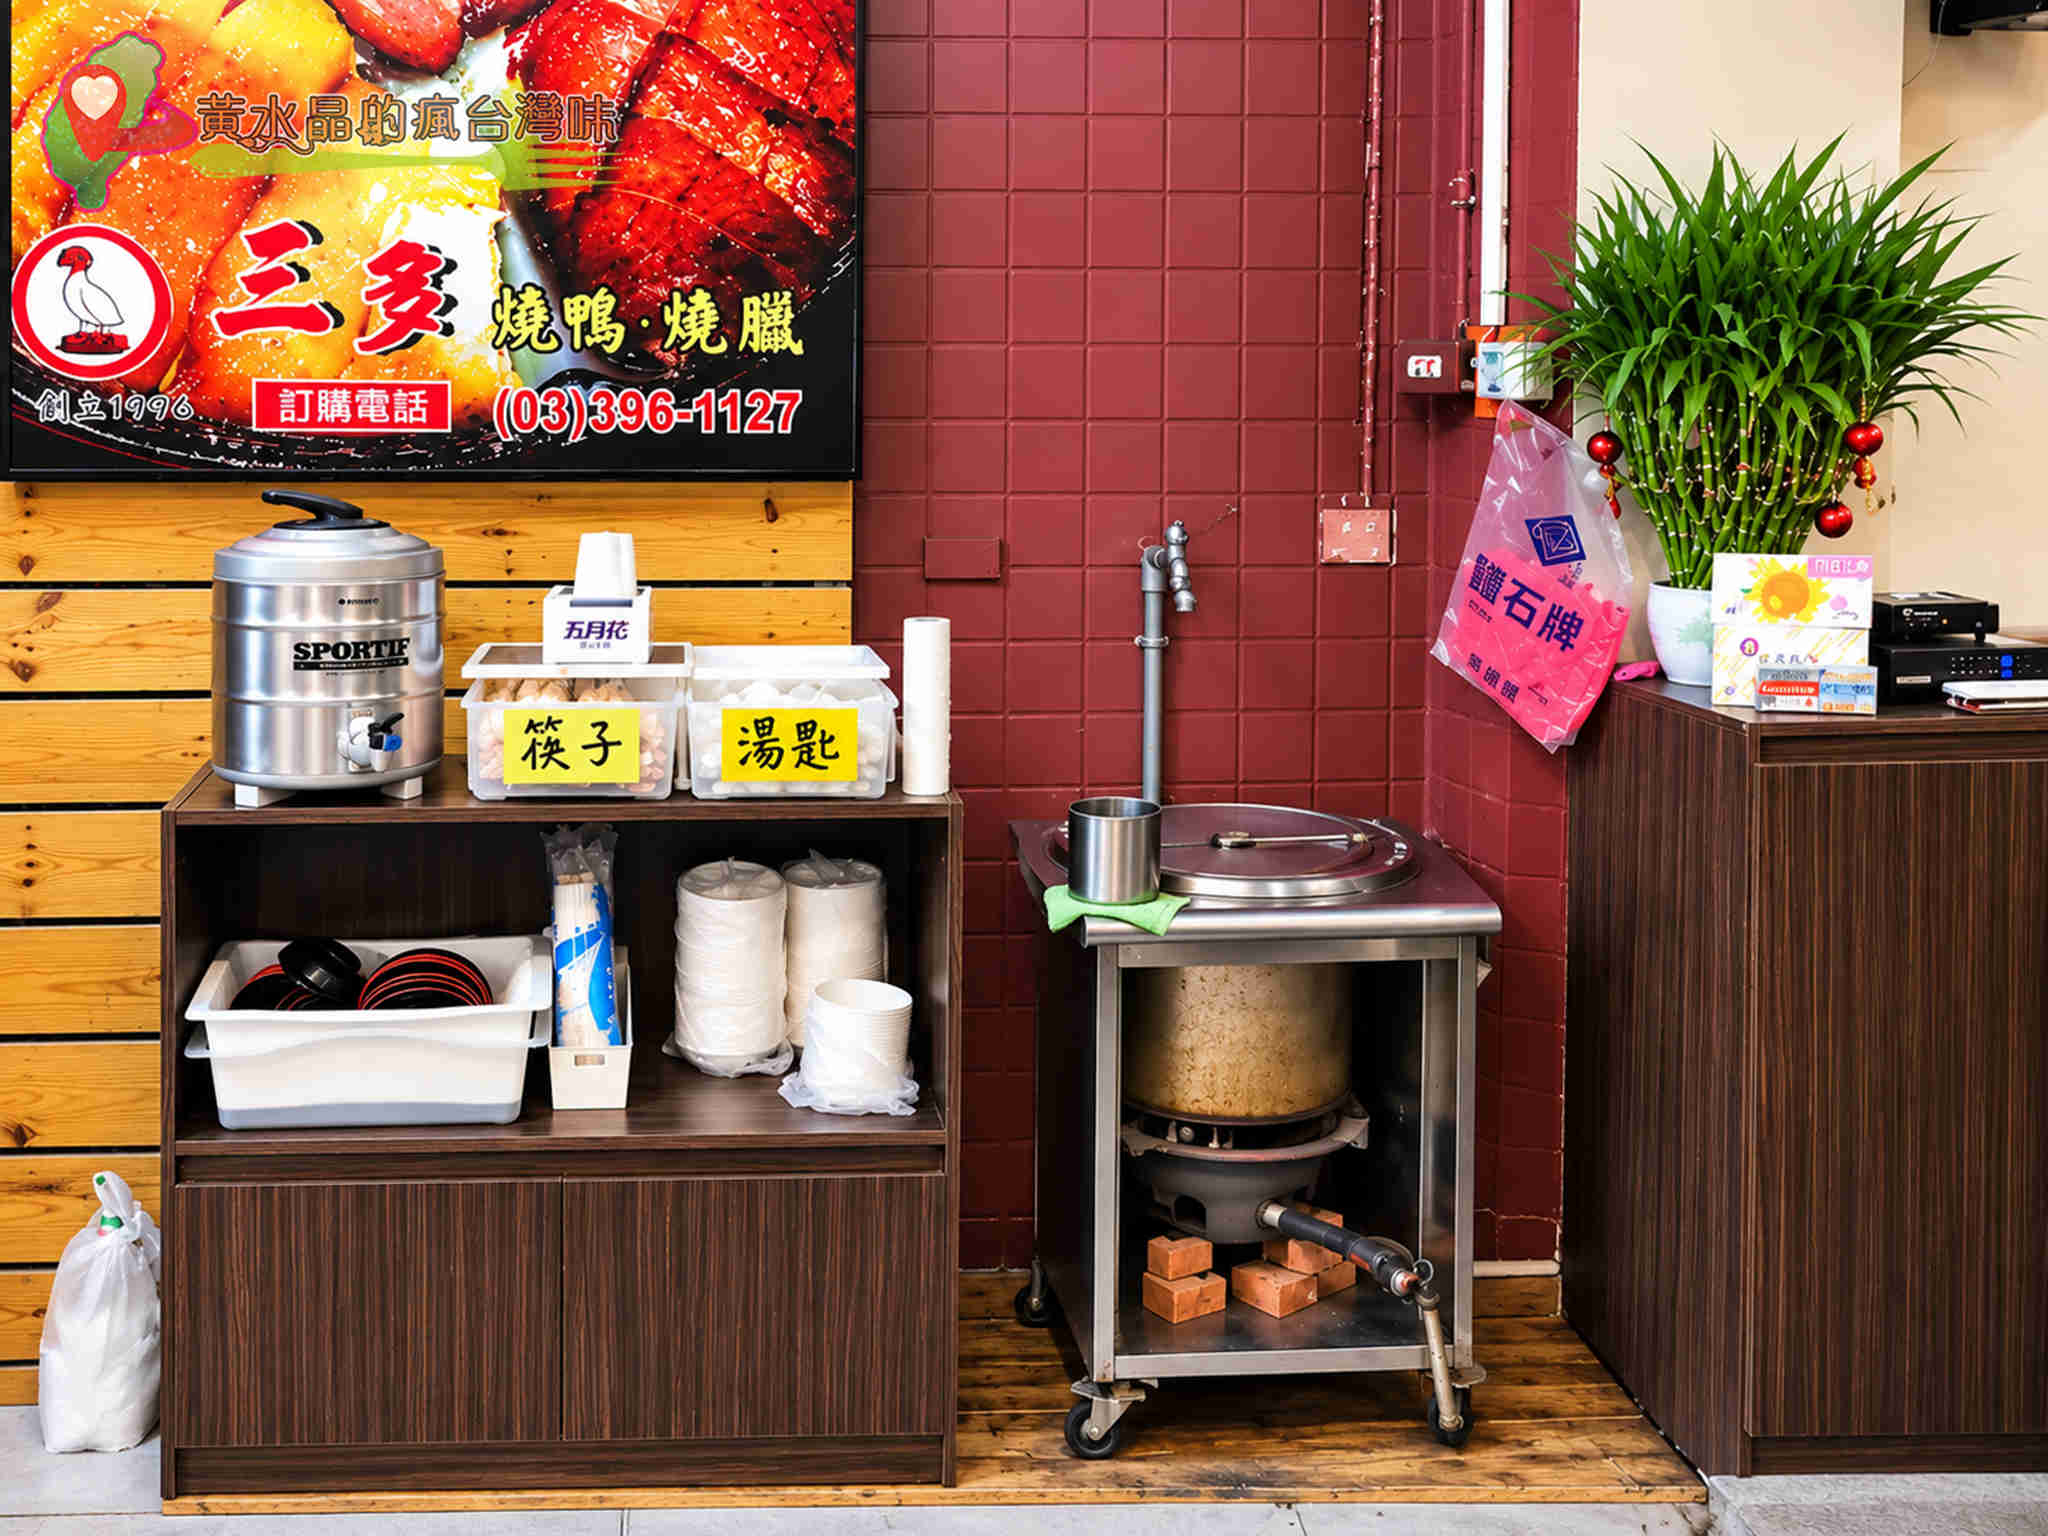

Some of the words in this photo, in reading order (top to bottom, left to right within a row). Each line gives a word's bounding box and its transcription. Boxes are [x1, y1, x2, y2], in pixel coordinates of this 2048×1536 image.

[211, 218, 458, 356] 三多
[36, 389, 195, 423] 創立1996
[278, 388, 429, 424] 訂購電話
[492, 386, 803, 442] (03)396-1127
[293, 637, 411, 660] SPORTIF
[562, 619, 630, 640] 五月花
[520, 715, 623, 771] 筷子
[736, 715, 841, 770] 湯匙
